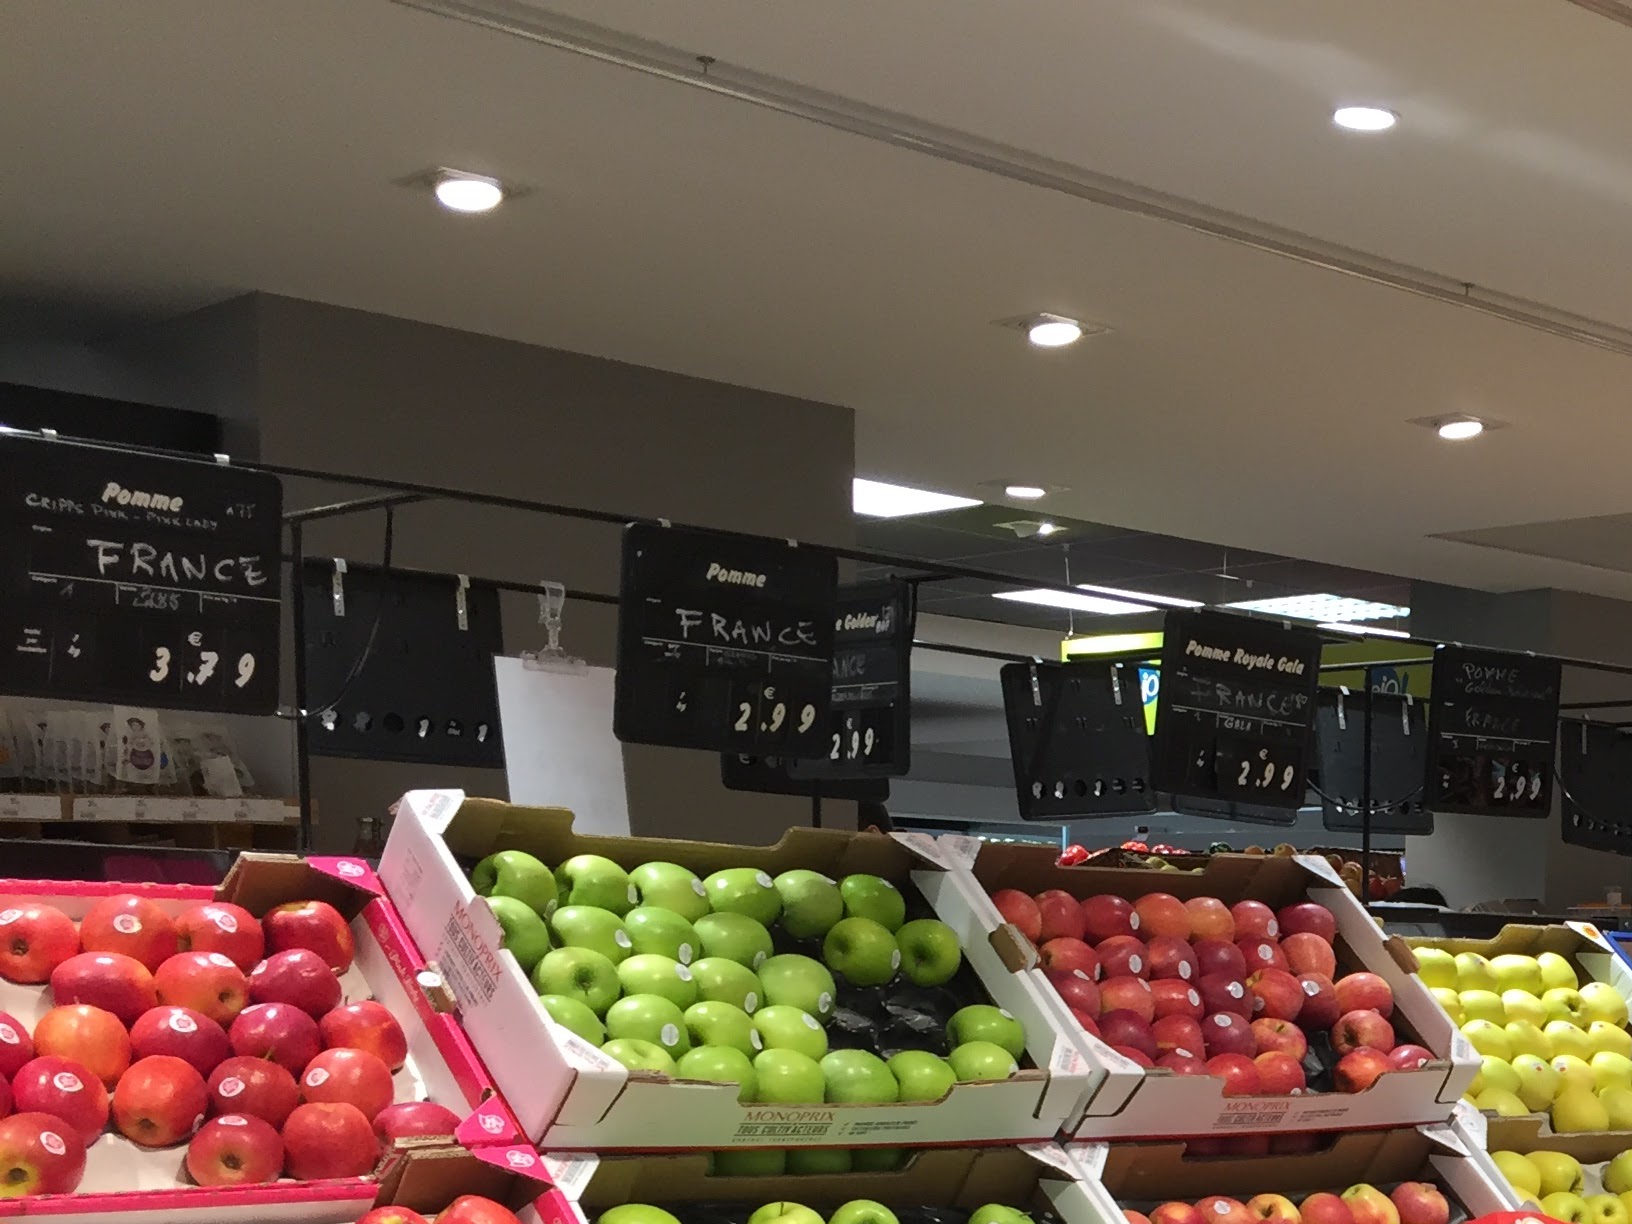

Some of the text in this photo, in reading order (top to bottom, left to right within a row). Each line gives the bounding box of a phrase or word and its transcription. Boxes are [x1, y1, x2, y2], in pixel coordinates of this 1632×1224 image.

[101, 481, 184, 513] Pomme
[86, 538, 268, 587] FRANCE
[706, 562, 768, 588] Pomme
[675, 608, 817, 646] FRANCE
[1185, 639, 1306, 677] Pomme Royale Gala
[454, 898, 503, 983] MONOPRIX
[743, 1110, 837, 1123] MONOPRIX
[1224, 1101, 1293, 1112] MONOPRIX
